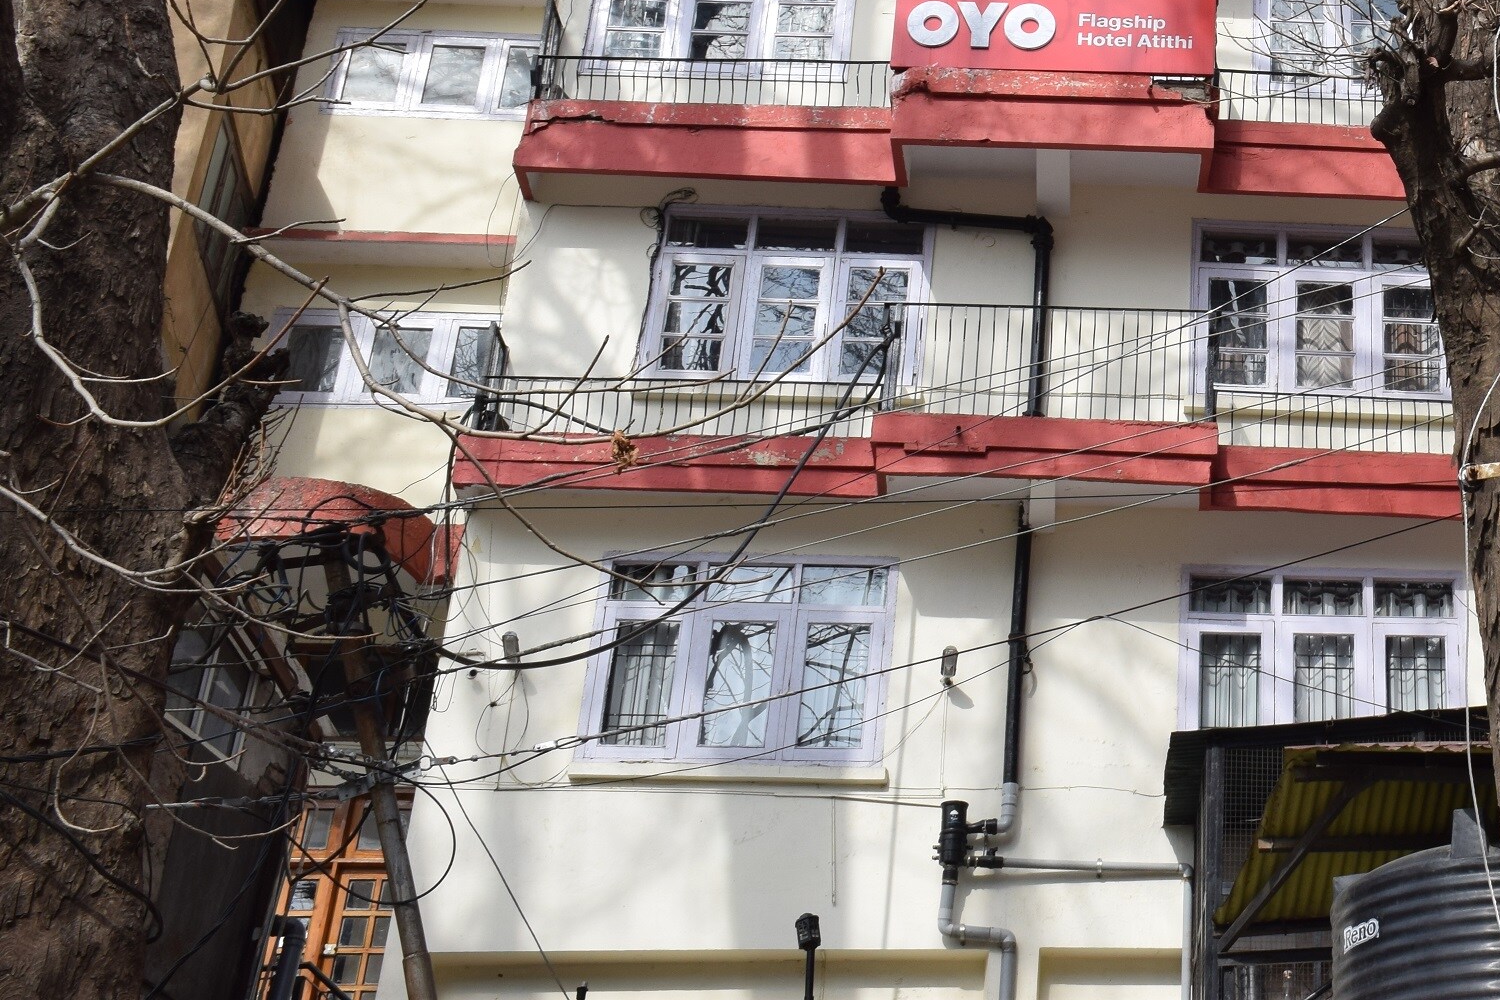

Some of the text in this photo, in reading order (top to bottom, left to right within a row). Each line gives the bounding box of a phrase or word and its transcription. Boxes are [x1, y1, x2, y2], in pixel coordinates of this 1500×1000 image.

[906, 0, 1056, 51] OYO
[1078, 13, 1166, 32] Flagship
[1077, 32, 1193, 50] Hotel Atithi
[1344, 919, 1378, 952] Reno
